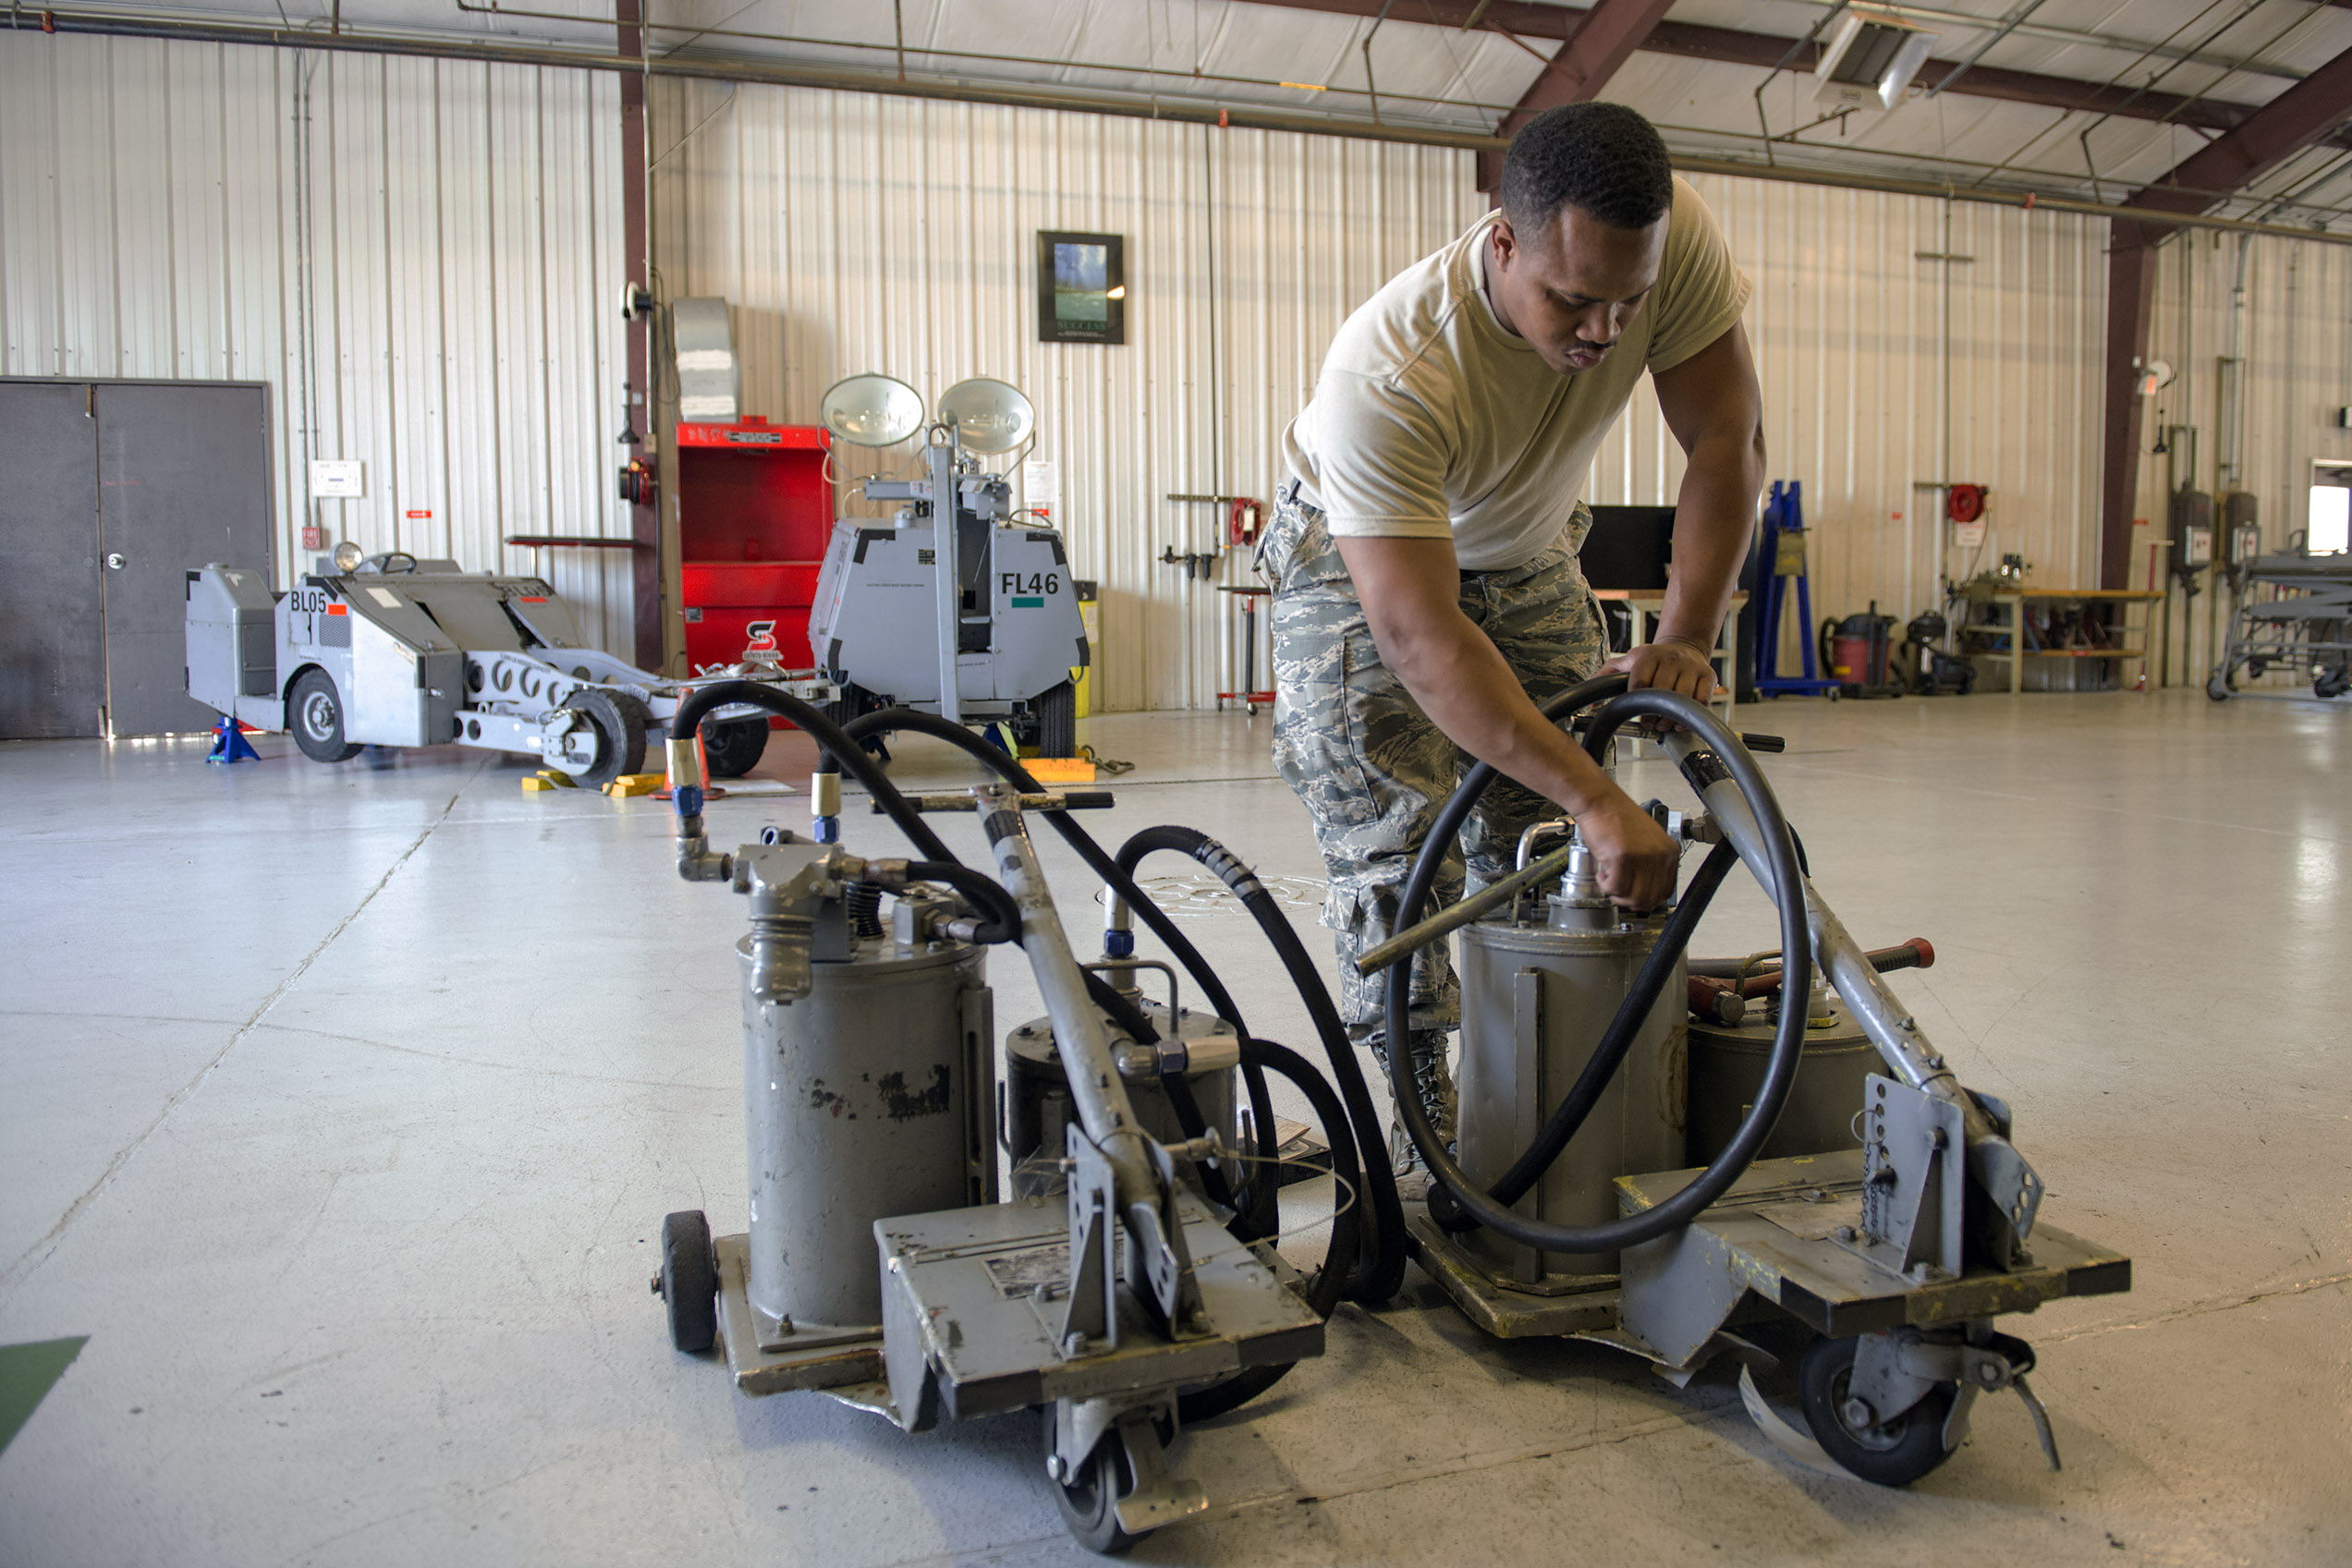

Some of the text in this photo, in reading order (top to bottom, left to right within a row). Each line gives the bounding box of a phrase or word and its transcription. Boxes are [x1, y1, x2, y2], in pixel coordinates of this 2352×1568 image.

[1057, 321, 1106, 331] SUCCESS
[1002, 573, 1058, 594] FL46
[291, 591, 326, 613] BL05
